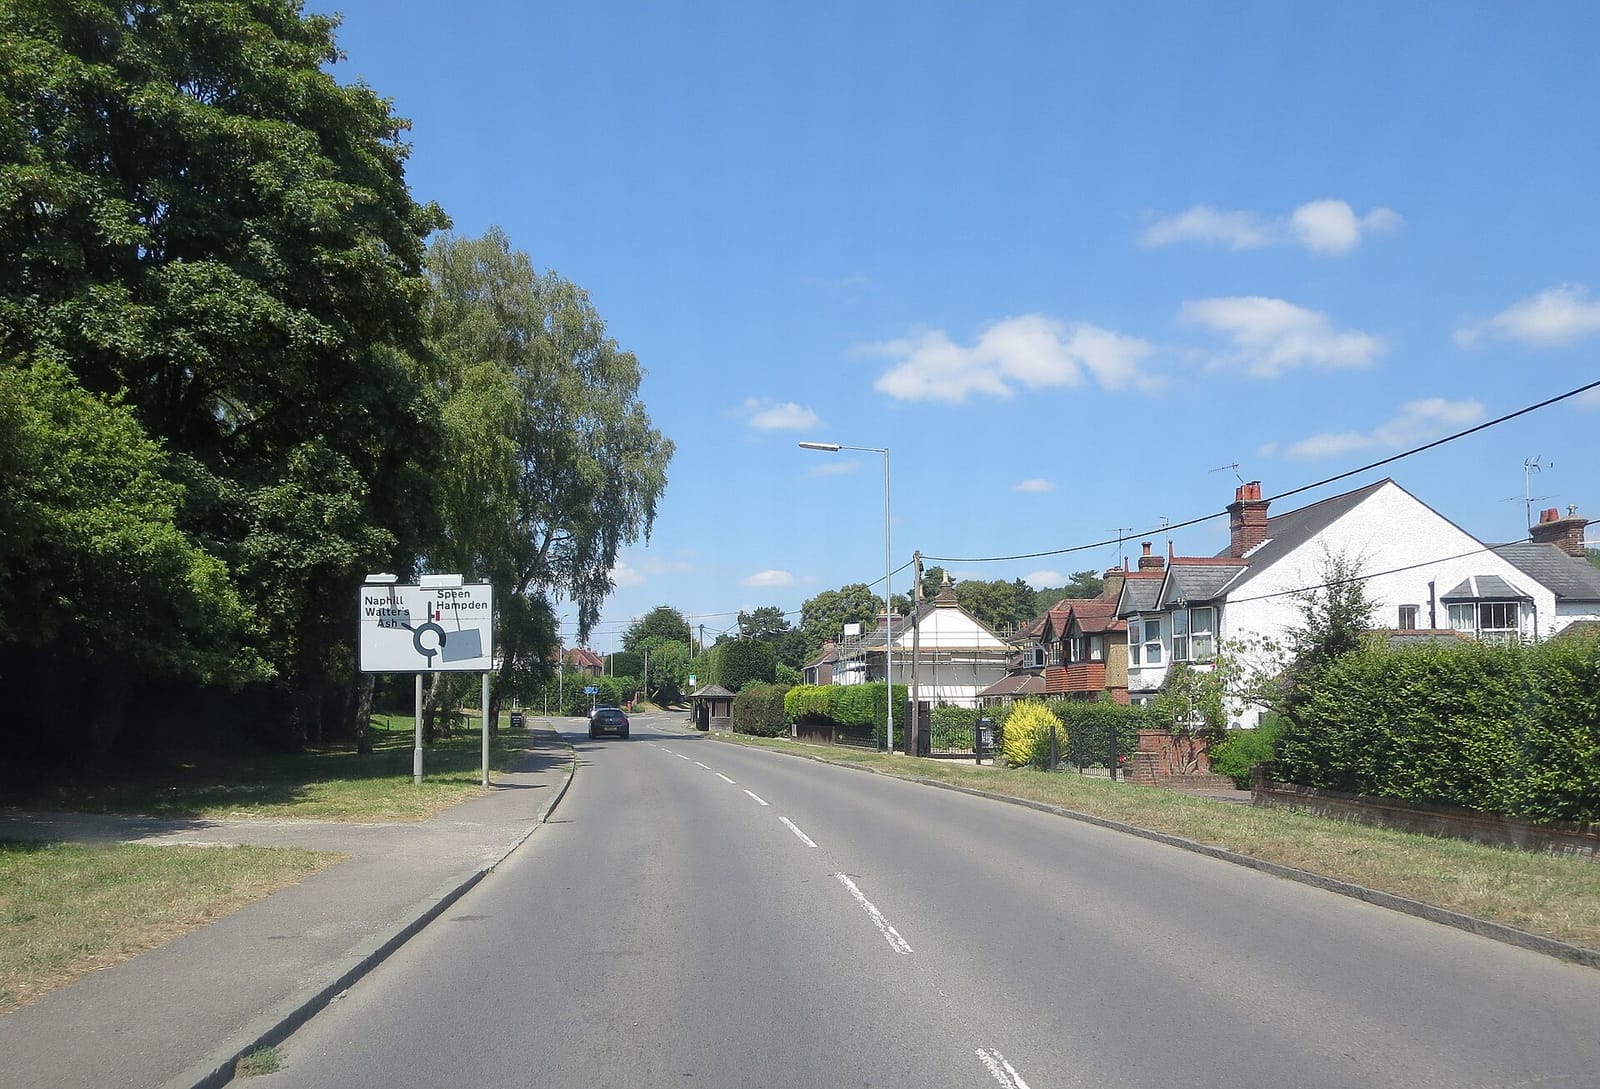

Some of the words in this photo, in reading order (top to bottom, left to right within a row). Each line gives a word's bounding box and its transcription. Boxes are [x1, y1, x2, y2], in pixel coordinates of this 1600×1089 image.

[437, 590, 470, 600] Speen
[365, 596, 404, 606] Naphill
[436, 601, 488, 610] Hampden
[366, 607, 410, 616] Walter's
[377, 619, 398, 628] Ash
